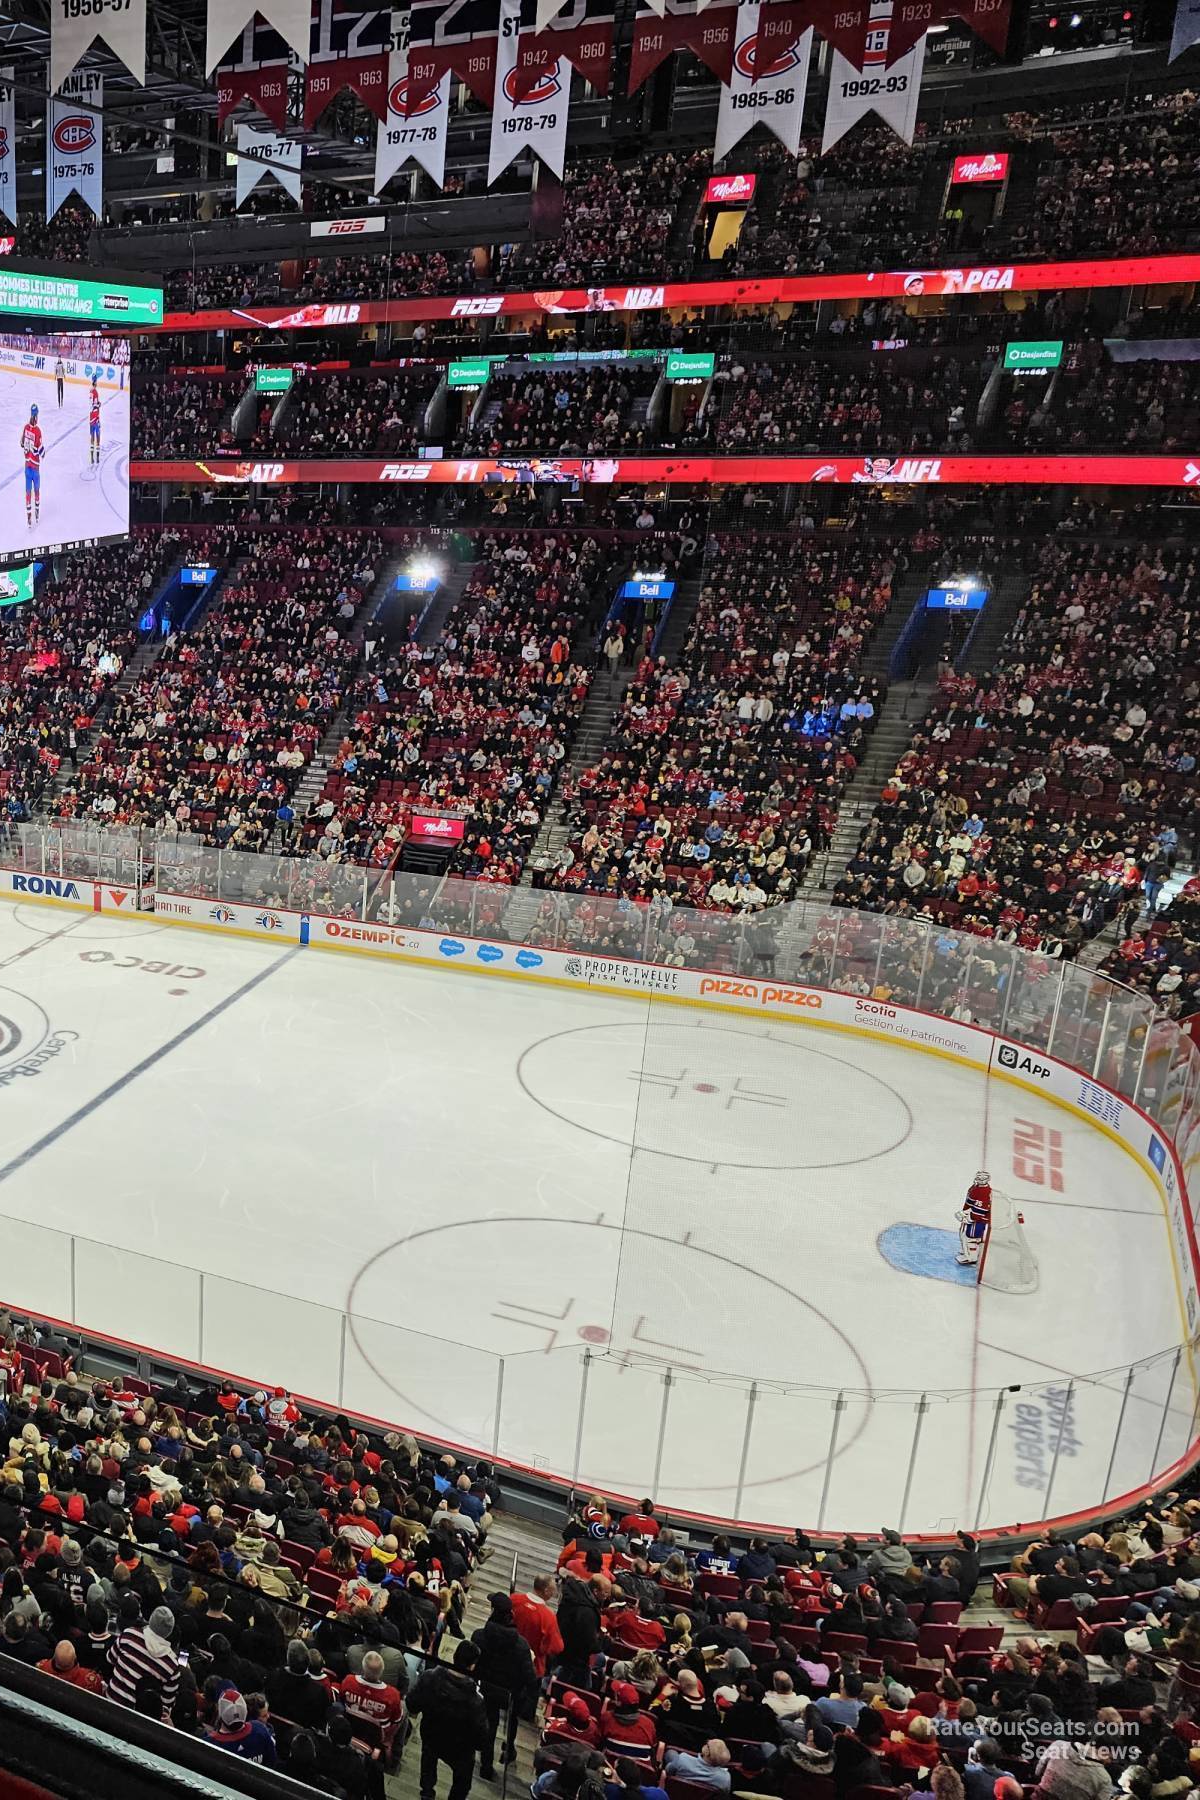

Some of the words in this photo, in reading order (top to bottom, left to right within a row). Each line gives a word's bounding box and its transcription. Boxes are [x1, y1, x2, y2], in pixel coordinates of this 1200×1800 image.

[834, 10, 861, 29] 1954
[901, 3, 932, 22] 1923
[703, 28, 728, 45] 1956
[764, 20, 792, 37] 1940
[580, 42, 605, 59] 1960
[639, 35, 663, 52] 1941
[468, 56, 491, 72] 1961
[522, 50, 548, 66] 1942
[359, 70, 382, 86] 1963
[413, 64, 435, 79] 1947
[260, 83, 281, 98] 1963
[309, 77, 330, 93] 1951
[841, 75, 908, 97] 1992-93
[731, 88, 795, 109] 1985-86
[502, 114, 557, 133] 1978-79
[386, 127, 438, 144] 1977-78
[246, 142, 292, 158] 1976-77
[52, 163, 95, 179] 1975-76
[958, 162, 1002, 178] Molson
[711, 181, 751, 199] Molson
[963, 268, 1015, 290] PGA
[30, 279, 39, 293] LE
[40, 280, 56, 295] LIEN
[57, 282, 79, 298] ENTRE
[8, 292, 18, 307] LE
[19, 293, 43, 310] SPORT
[43, 296, 58, 312] QUE
[450, 297, 504, 315] RDS
[622, 287, 665, 308] NBA
[323, 304, 361, 323] MLB
[1020, 350, 1057, 360] Desjardins
[66, 361, 77, 375] Bell
[679, 361, 710, 371] Desjardins
[252, 463, 285, 481] ATP
[379, 464, 432, 480] RDS
[455, 463, 479, 480] F1
[898, 460, 941, 481] NFL
[192, 571, 207, 582] Bell
[409, 577, 427, 589] Bell
[639, 582, 659, 597] Bell
[944, 592, 968, 607] Bell
[422, 822, 452, 835] Molson
[12, 874, 80, 900] RONA
[173, 903, 192, 914] TIRE
[114, 955, 207, 980] CIBC
[632, 967, 679, 984] TWELVE
[583, 971, 609, 983] IRISH
[623, 977, 678, 991] WHISKEY
[699, 978, 759, 999] pizza
[761, 986, 823, 1010] pizza
[855, 999, 897, 1019] Scotia
[854, 1012, 894, 1032] Gestion
[895, 1023, 909, 1035] de
[1076, 1078, 1124, 1131] IBM
[1038, 1387, 1084, 1458] sports
[1007, 1402, 1050, 1491] experts
[345, 1690, 387, 1714] GALLAGHER
